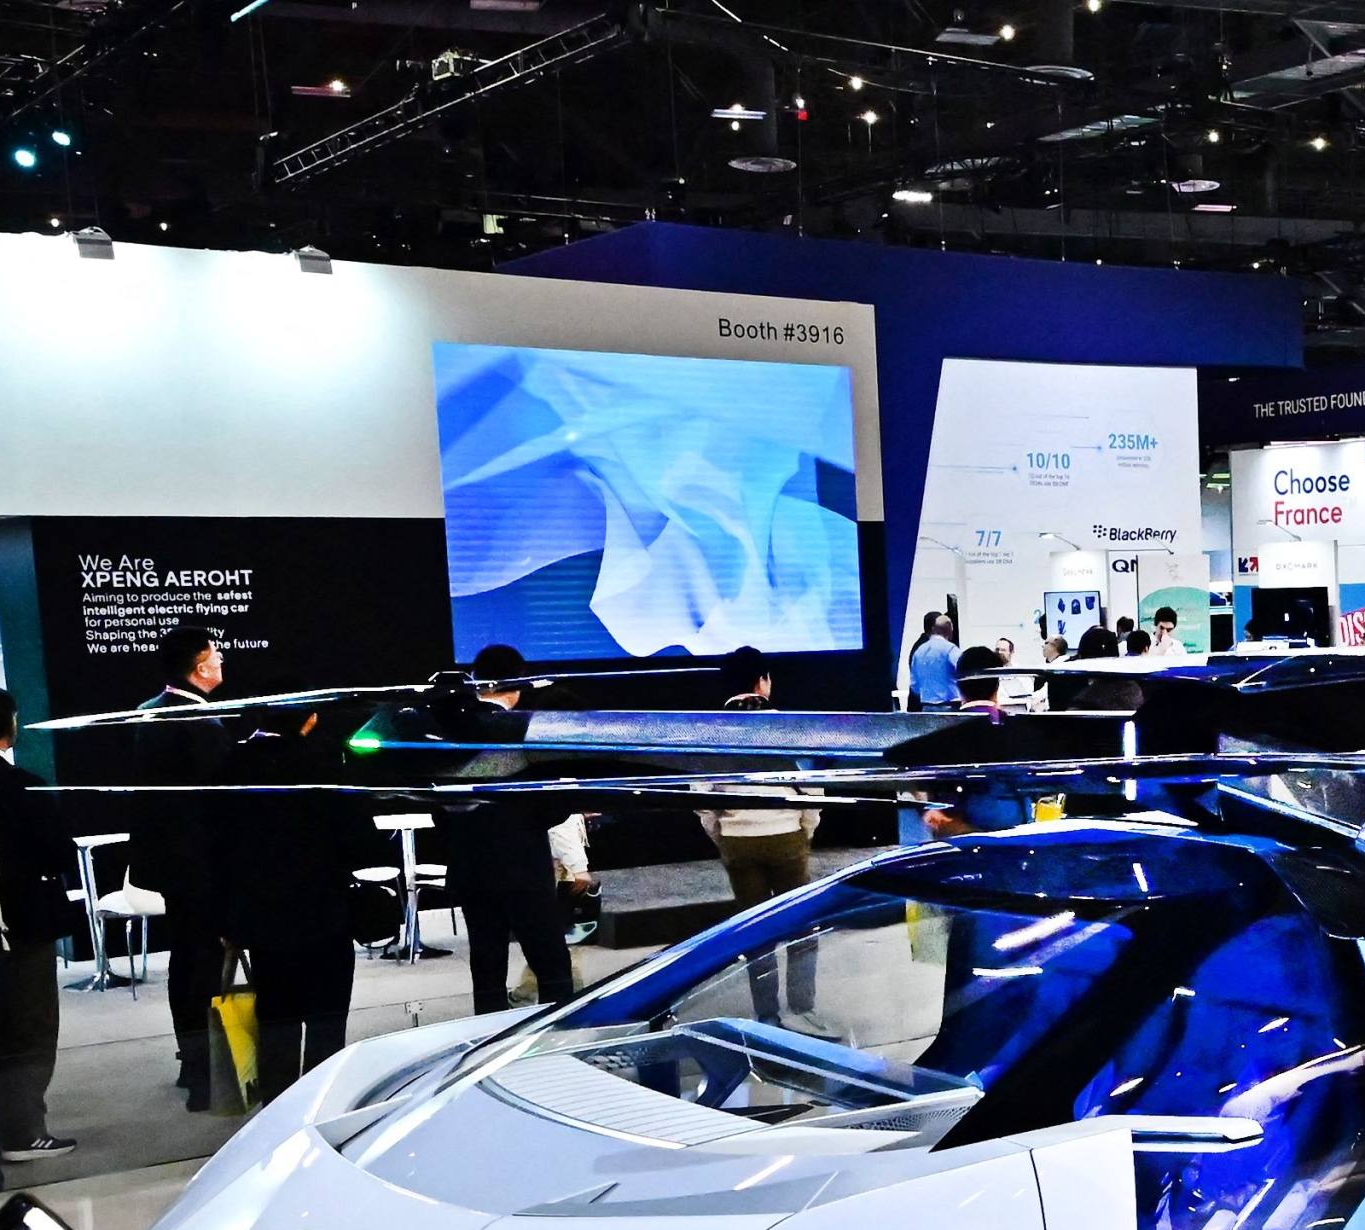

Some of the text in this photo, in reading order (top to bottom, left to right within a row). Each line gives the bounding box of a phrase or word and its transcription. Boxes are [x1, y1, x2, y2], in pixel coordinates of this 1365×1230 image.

[718, 318, 844, 345] Booth #3916
[1253, 402, 1275, 418] THE
[1278, 396, 1328, 415] TRUSTED
[1108, 433, 1158, 450] 235M+
[1026, 452, 1071, 469] 10/10
[1274, 468, 1350, 496] Choose
[1274, 501, 1343, 526] France
[975, 530, 1001, 547] 7/7
[1109, 527, 1177, 543] BlackBerry
[78, 554, 155, 571] We Are
[81, 569, 253, 588] XPENG AEROHT
[83, 589, 253, 605] Aiming to produce the safest
[82, 602, 250, 618] intelligent electric flying car
[85, 615, 180, 629] for personal use
[85, 629, 137, 642] Shaping
[138, 628, 158, 639] the
[87, 643, 108, 654] We
[110, 643, 130, 653] are
[233, 638, 270, 649] future
